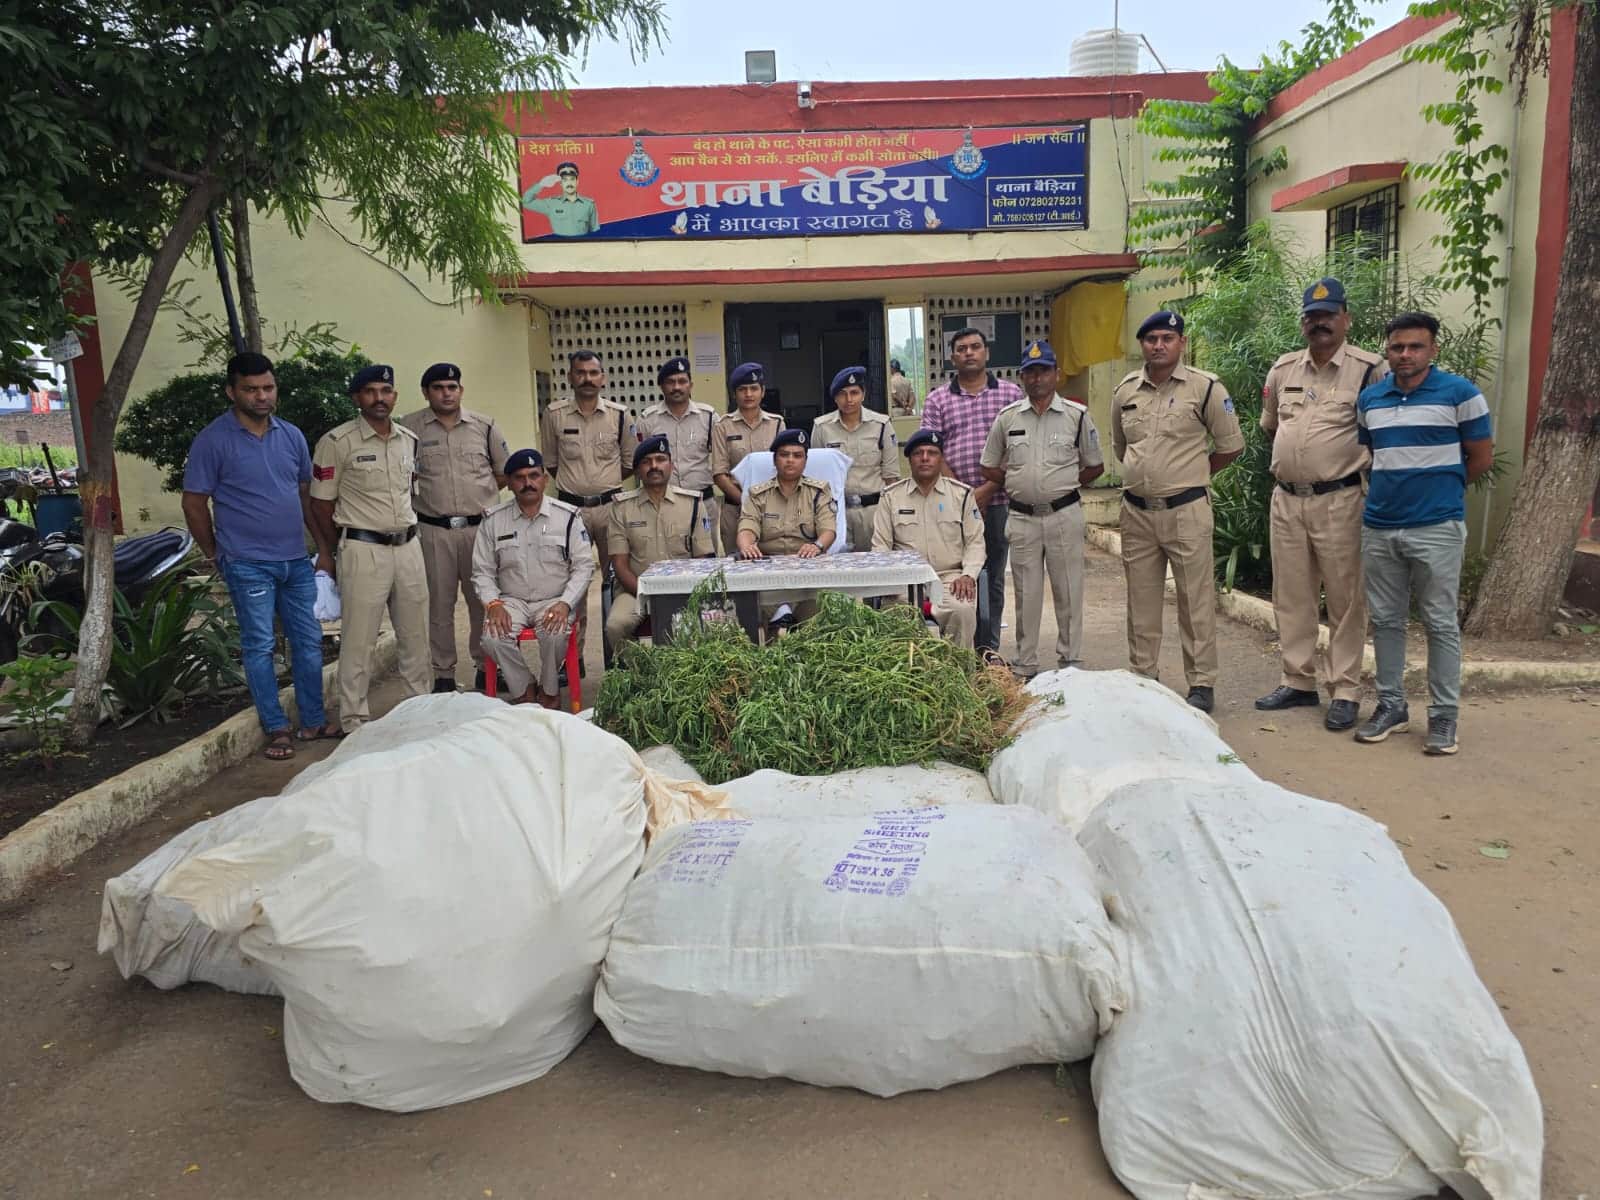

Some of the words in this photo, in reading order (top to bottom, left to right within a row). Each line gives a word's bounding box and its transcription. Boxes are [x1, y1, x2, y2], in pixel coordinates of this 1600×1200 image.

[713, 138, 727, 150] हो
[729, 138, 755, 150] थाने
[758, 137, 770, 149] के
[797, 136, 821, 148] ऐसा
[824, 134, 852, 147] कभी
[855, 134, 880, 147] होता
[884, 133, 908, 146] नहीं
[1024, 132, 1046, 144] जन
[1050, 130, 1073, 144] सेवा
[529, 141, 550, 155] देश
[554, 140, 583, 155] भक्ति
[670, 156, 694, 166] आप
[721, 153, 732, 165] से
[735, 153, 751, 165] सो
[846, 148, 873, 161] कभी
[876, 149, 905, 161] सोता
[660, 179, 788, 208] थाना
[799, 166, 952, 210] बेड़िया
[995, 183, 1032, 193] थाना
[992, 195, 1017, 207] फोन
[690, 213, 711, 232] में
[720, 216, 801, 232] आपका
[807, 214, 890, 230] स्वागत
[893, 208, 913, 229] है
[864, 829, 930, 838] SHEETING
